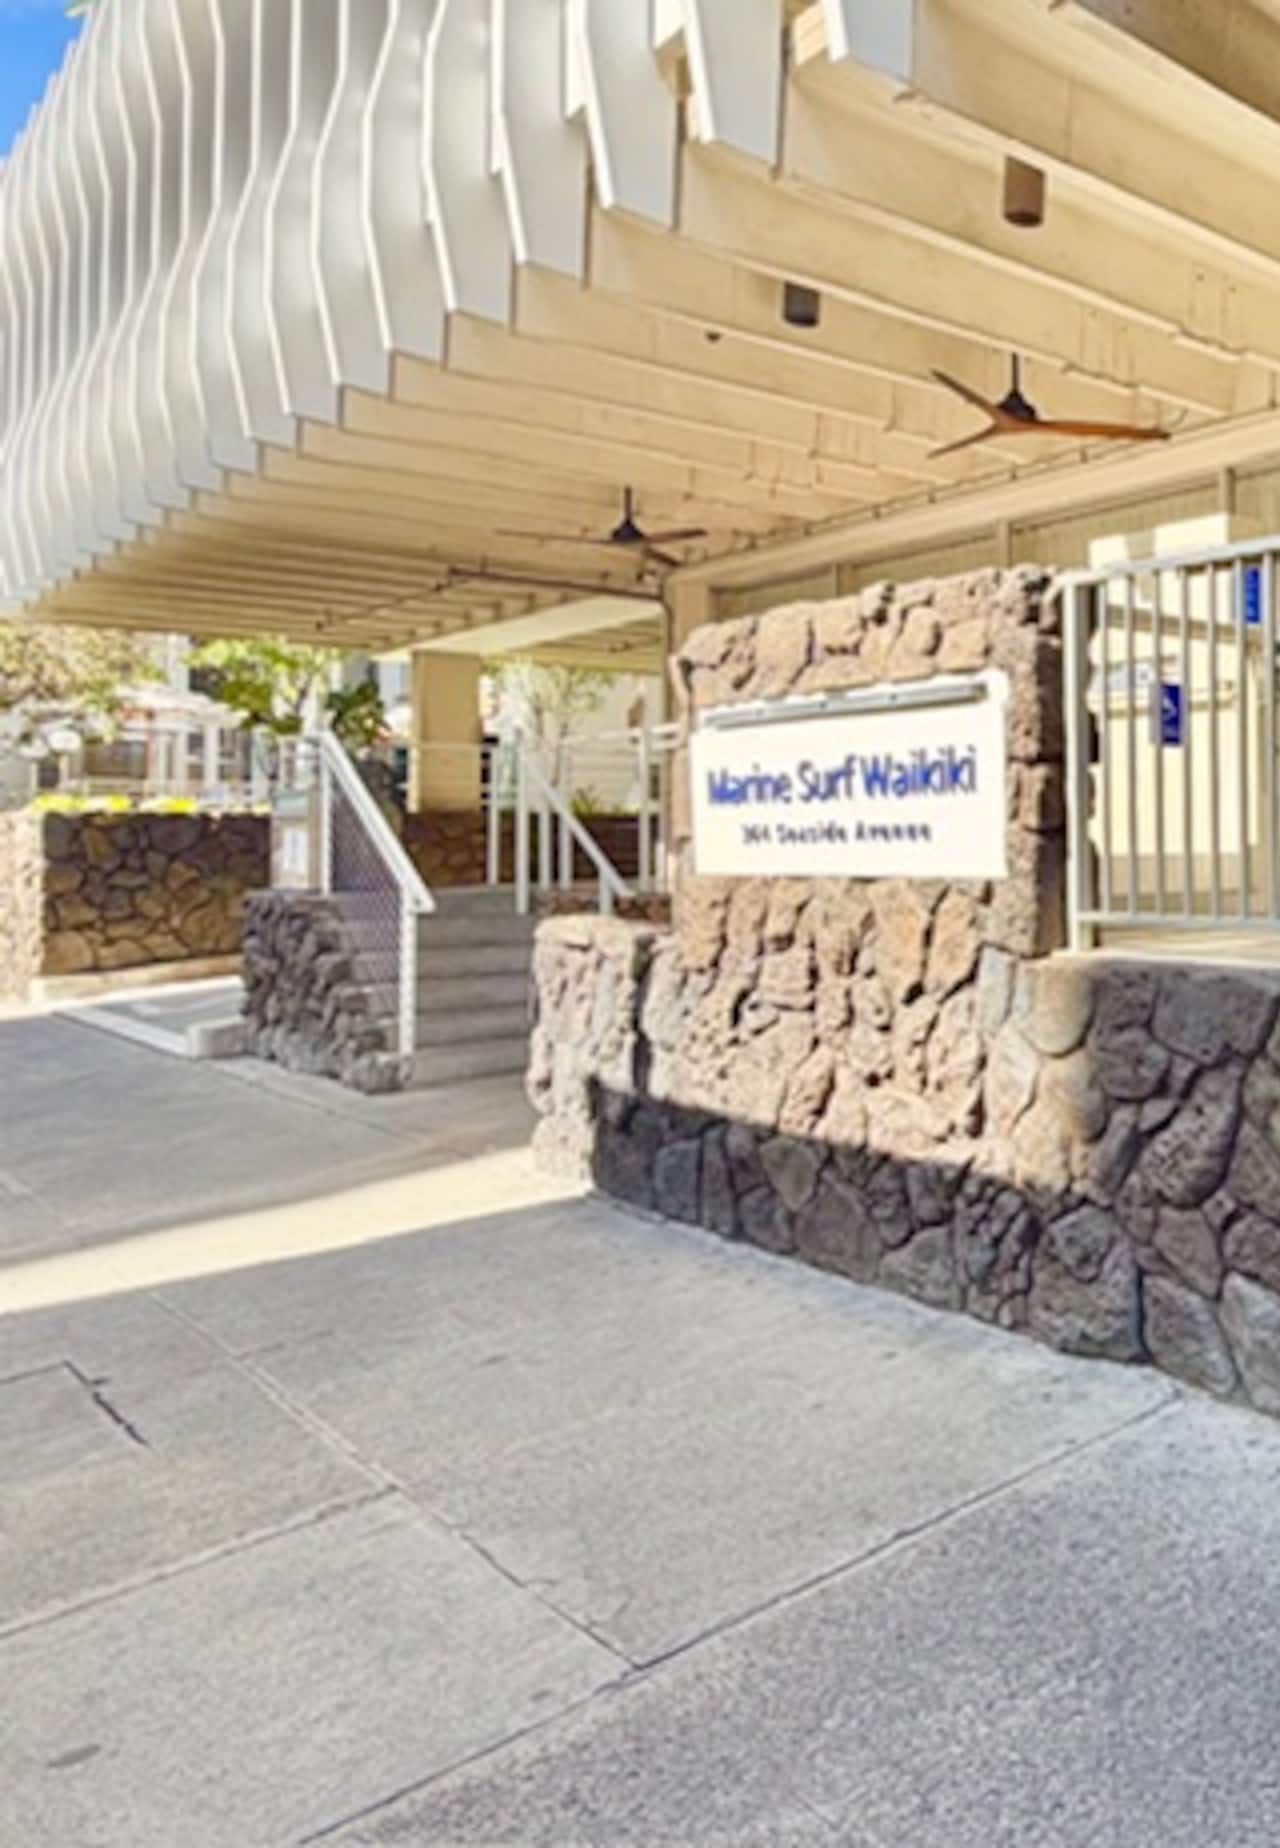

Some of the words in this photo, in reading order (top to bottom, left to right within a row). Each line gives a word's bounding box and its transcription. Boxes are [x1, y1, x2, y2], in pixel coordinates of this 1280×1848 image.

[708, 763, 792, 805] Marine
[798, 753, 856, 803] Surf
[860, 743, 977, 798] Waikiki
